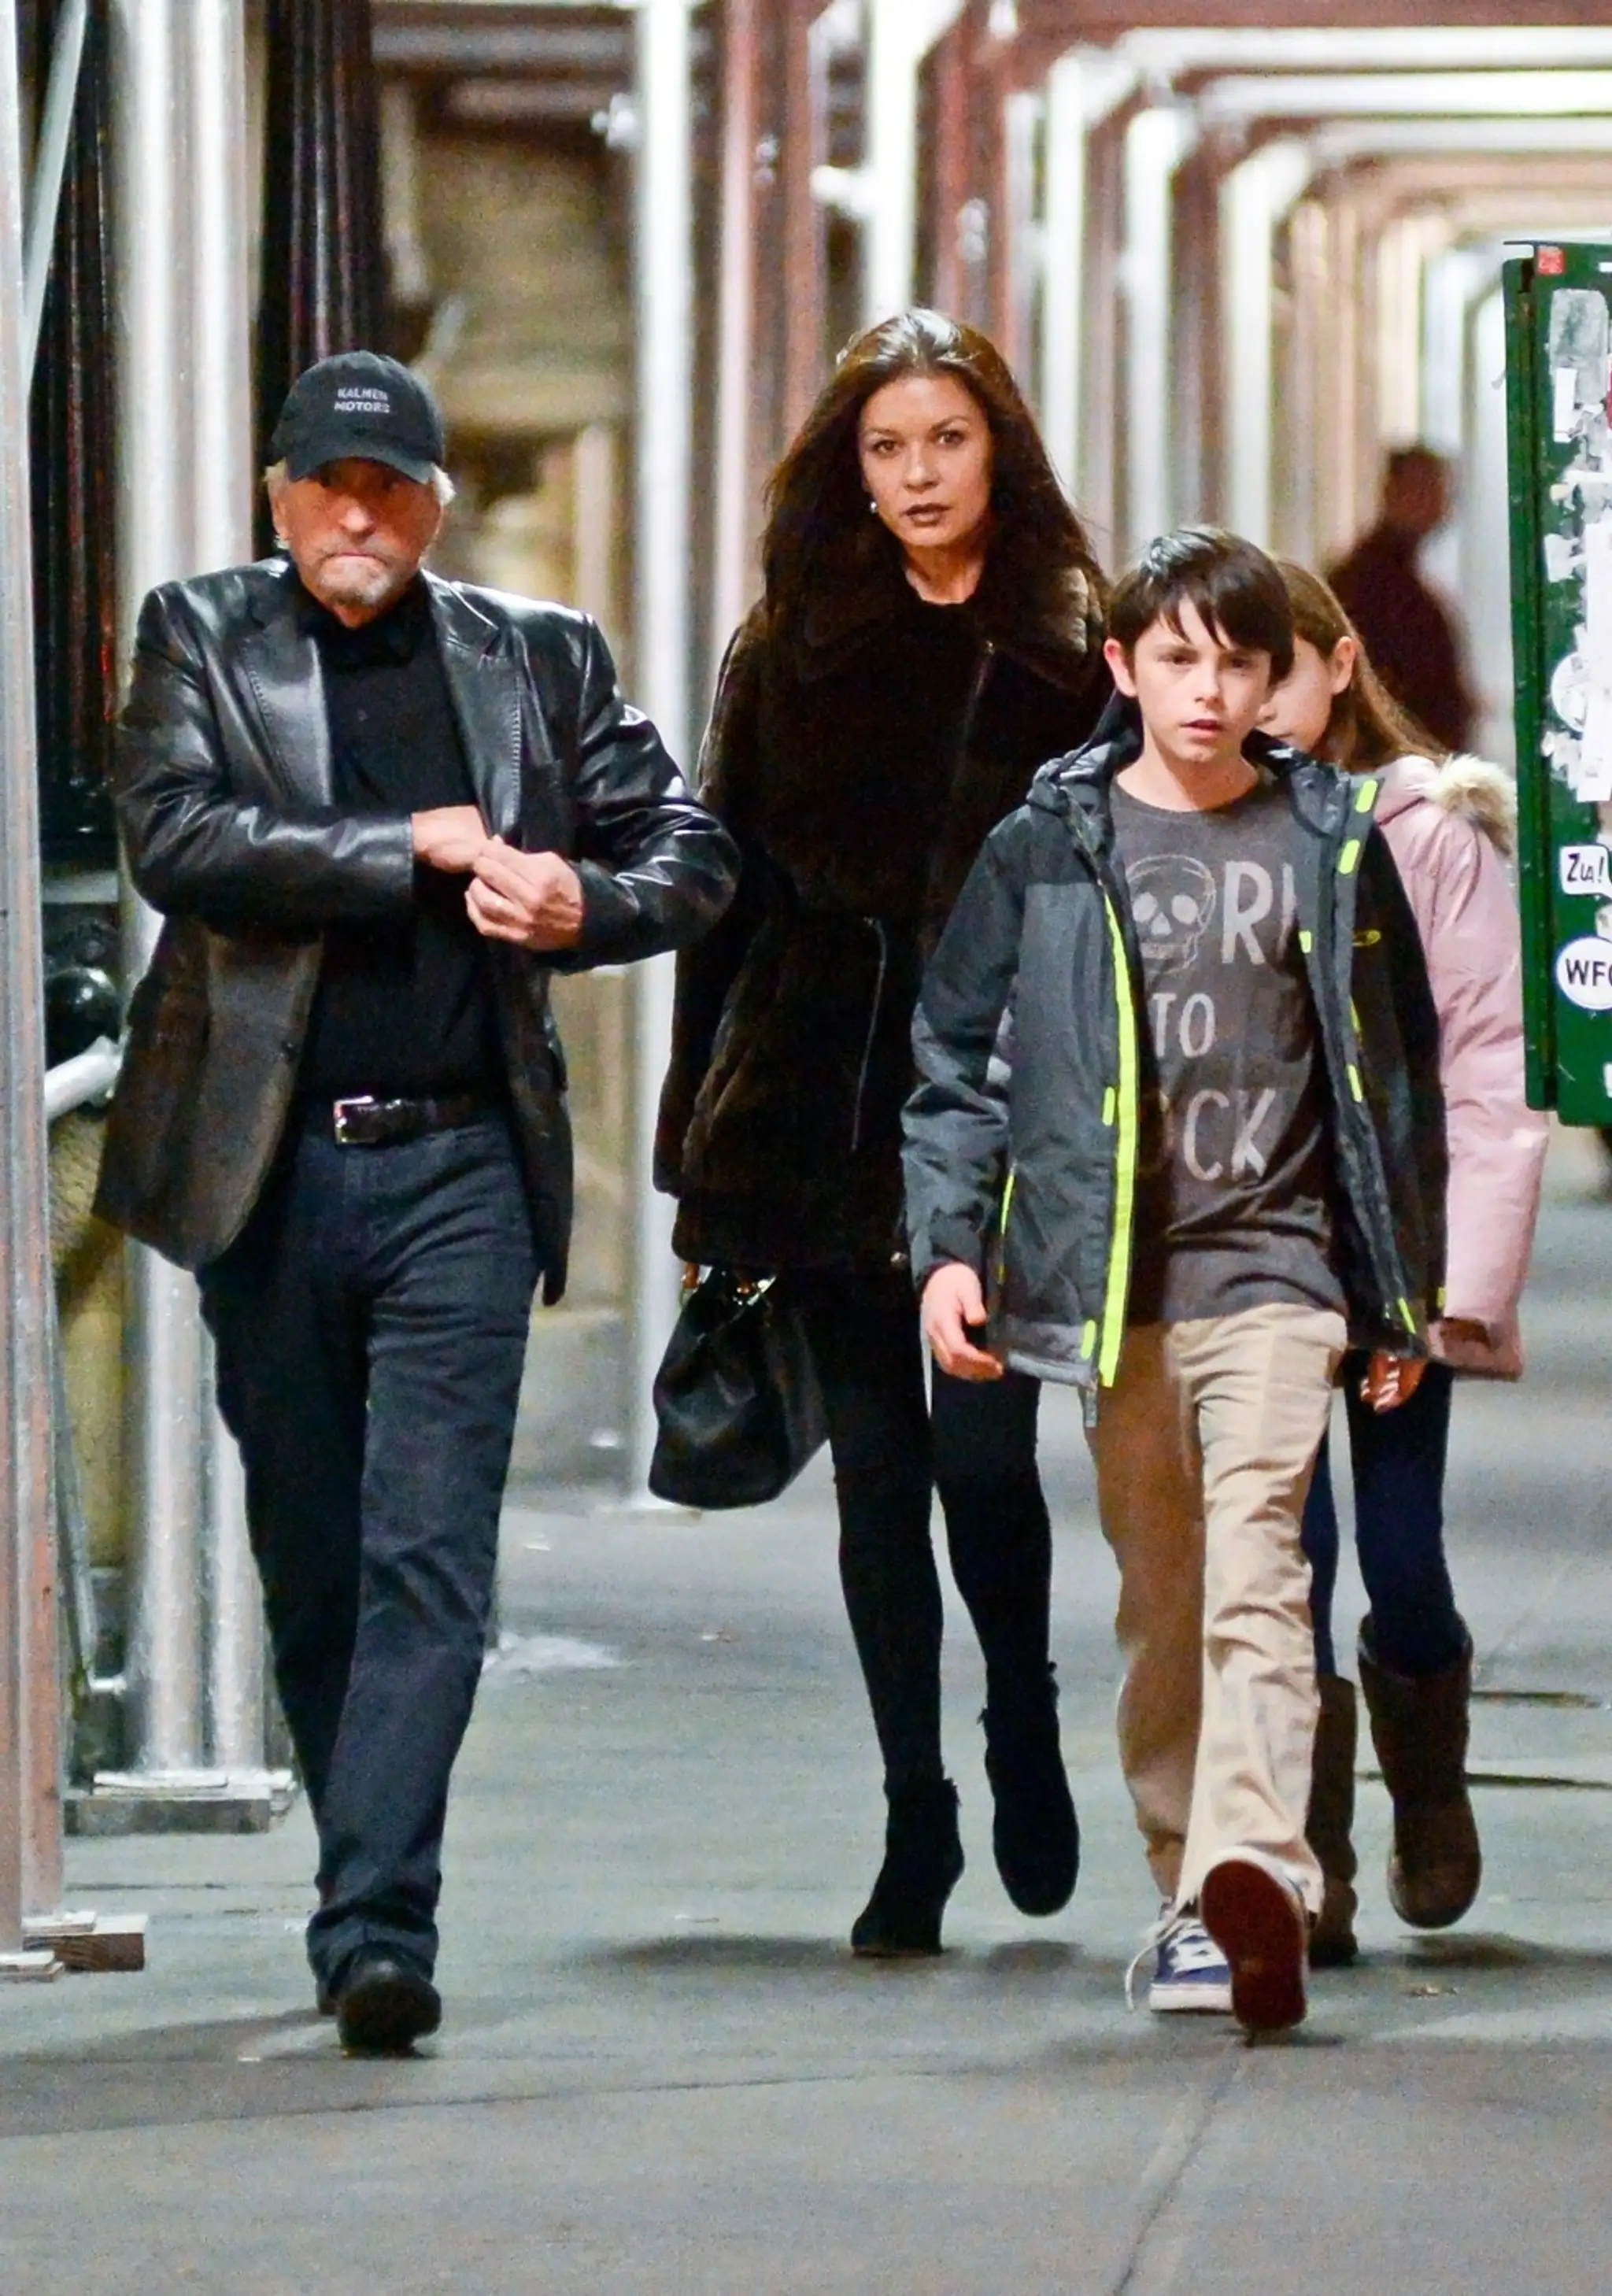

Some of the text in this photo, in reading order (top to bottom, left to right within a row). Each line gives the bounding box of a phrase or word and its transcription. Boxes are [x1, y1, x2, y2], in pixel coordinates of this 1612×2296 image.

[335, 401, 390, 412] MOTORS
[1152, 993, 1216, 1058] TO
[1162, 1089, 1277, 1181] CK
